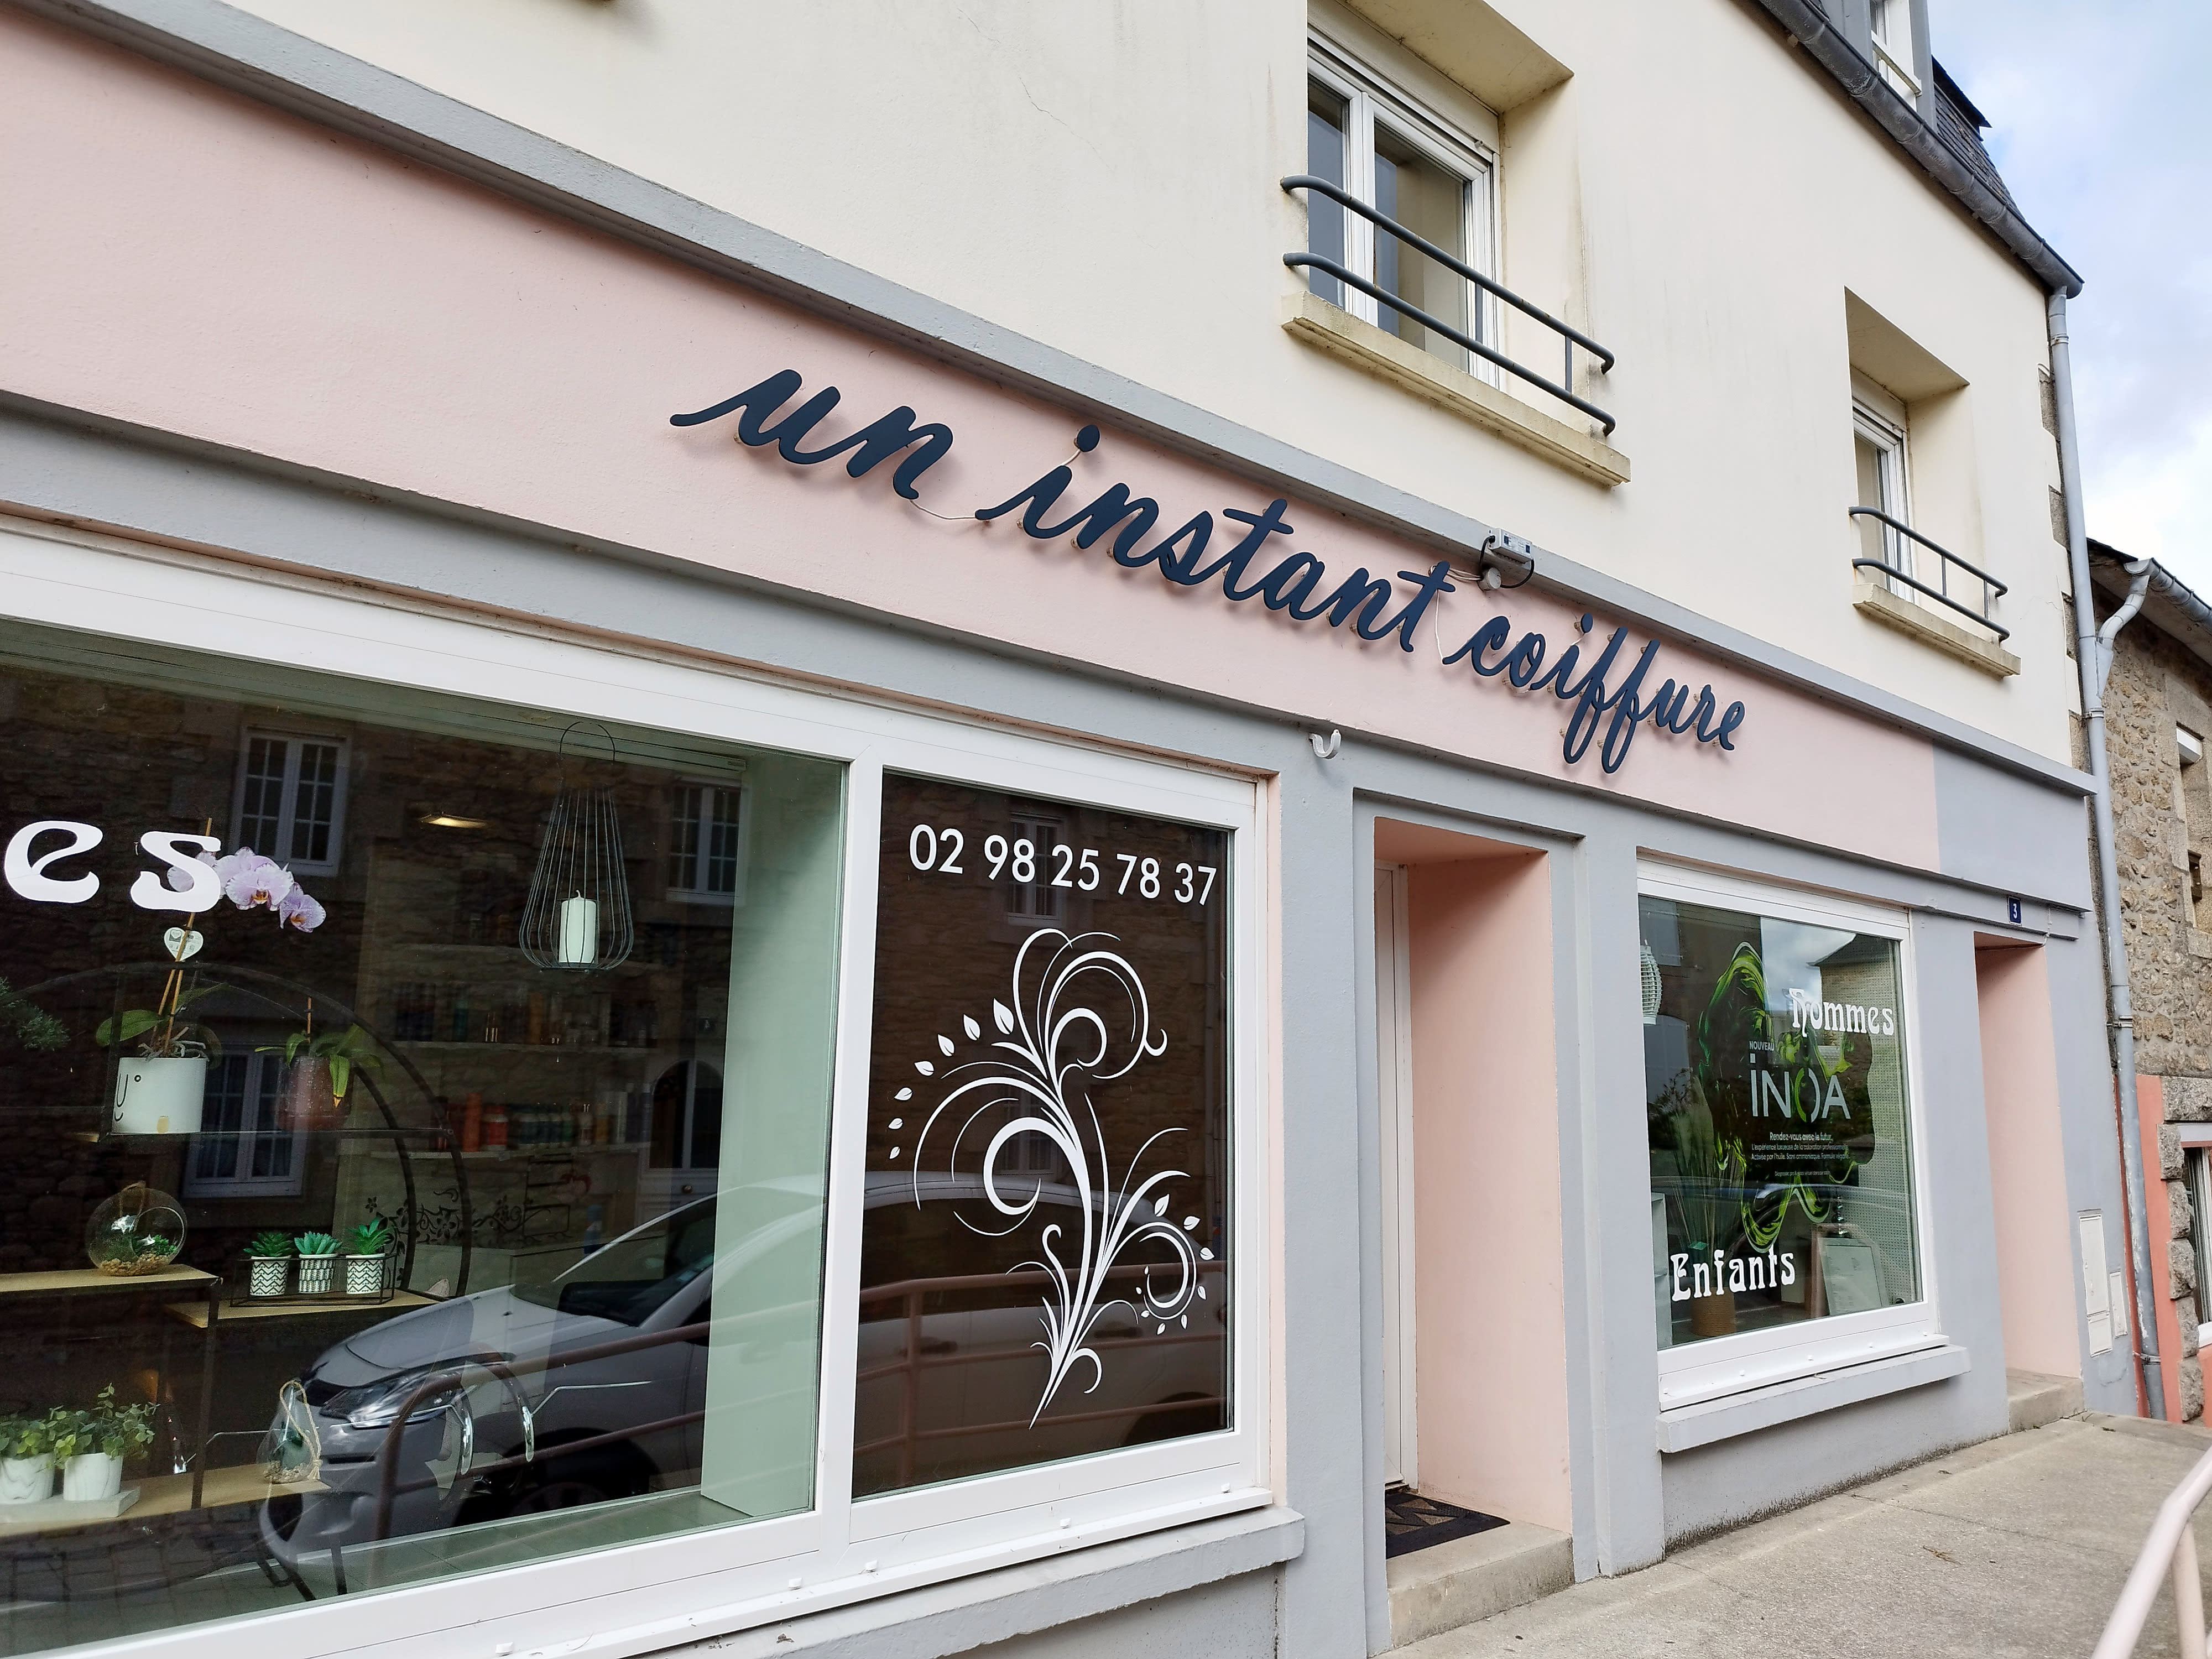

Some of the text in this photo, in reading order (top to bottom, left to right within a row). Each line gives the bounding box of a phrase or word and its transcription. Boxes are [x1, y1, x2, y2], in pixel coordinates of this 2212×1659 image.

[670, 369, 1745, 773] un instant coiffure
[909, 824, 1217, 905] 02 98 25 78 37
[2013, 903, 2017, 919] 3
[1749, 1040, 1775, 1051] NOUVEAU
[1770, 1131, 1802, 1141] Rendez-vous
[1815, 1132, 1820, 1141] le
[1670, 1243, 1796, 1302] Enfants
